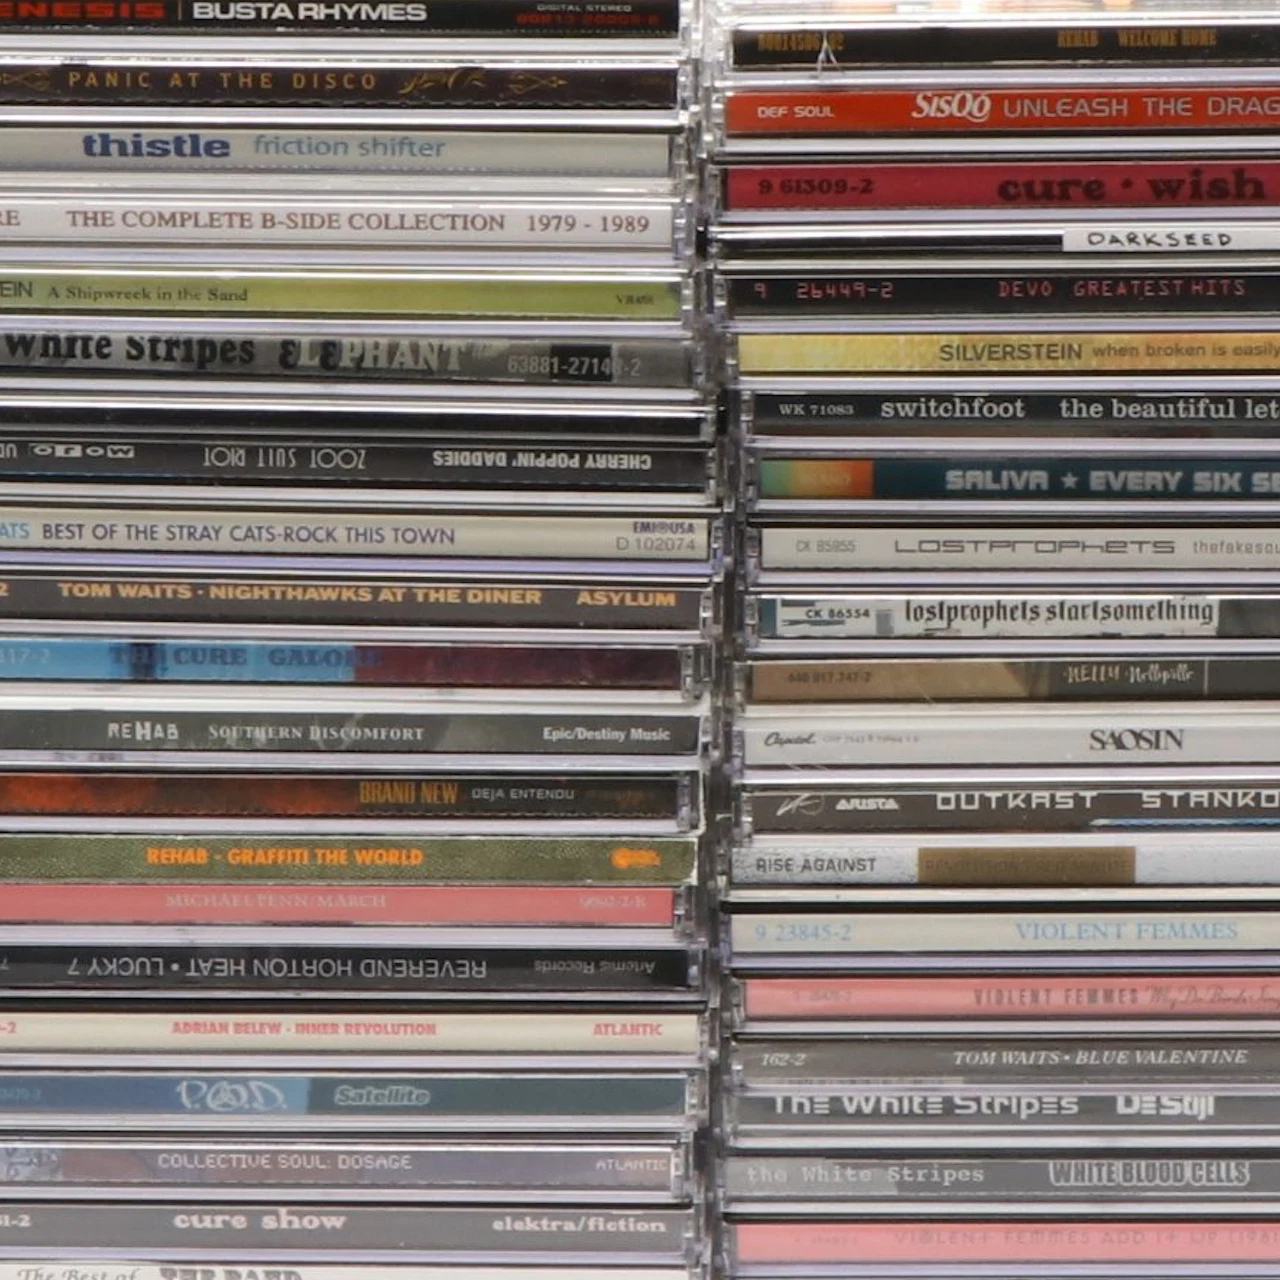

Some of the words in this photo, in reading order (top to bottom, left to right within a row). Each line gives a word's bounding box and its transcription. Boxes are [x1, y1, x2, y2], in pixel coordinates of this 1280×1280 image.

[194, 3, 293, 19] BUSTA
[299, 3, 426, 20] RHYMES
[758, 107, 787, 117] DEF
[794, 106, 833, 117] SOUL
[1004, 99, 1127, 117] UNLEASH
[1143, 96, 1192, 116] THE
[84, 134, 229, 157] thistle
[255, 133, 348, 155] friction
[356, 137, 446, 156] shifter
[998, 175, 1106, 201] cure
[1147, 170, 1265, 200] wish
[66, 211, 115, 227] THE
[122, 211, 253, 228] COMPLETE
[261, 213, 341, 229] B-SIDE
[348, 214, 505, 231] COLLECTION
[529, 215, 576, 231] 1979
[602, 216, 649, 232] 1989
[1088, 233, 1231, 247] DARKSEED
[940, 342, 1081, 361] SILVERSTEIN
[1093, 342, 1139, 357] when
[1146, 343, 1205, 357] broken
[1212, 347, 1227, 356] is
[1232, 343, 1280, 358] easily
[880, 397, 1028, 419] switchfoot
[1061, 396, 1103, 417] the
[1110, 397, 1237, 417] beautiful
[945, 471, 1049, 492] SALIVA
[1089, 471, 1182, 492] EVERY
[1193, 471, 1241, 493] SIX
[43, 524, 85, 539] BEST
[92, 524, 117, 540] OF
[125, 524, 158, 540] THE
[167, 525, 222, 541] STRAY
[230, 526, 337, 543] CATS-ROCK
[346, 527, 385, 543] THIS
[392, 528, 454, 544] TOWN
[1091, 730, 1182, 750] SAOSIN
[756, 856, 797, 873] RISE
[800, 856, 875, 872] AGAINST
[335, 1085, 430, 1107] Satellite
[174, 1215, 247, 1228] cure
[263, 1211, 345, 1229] show
